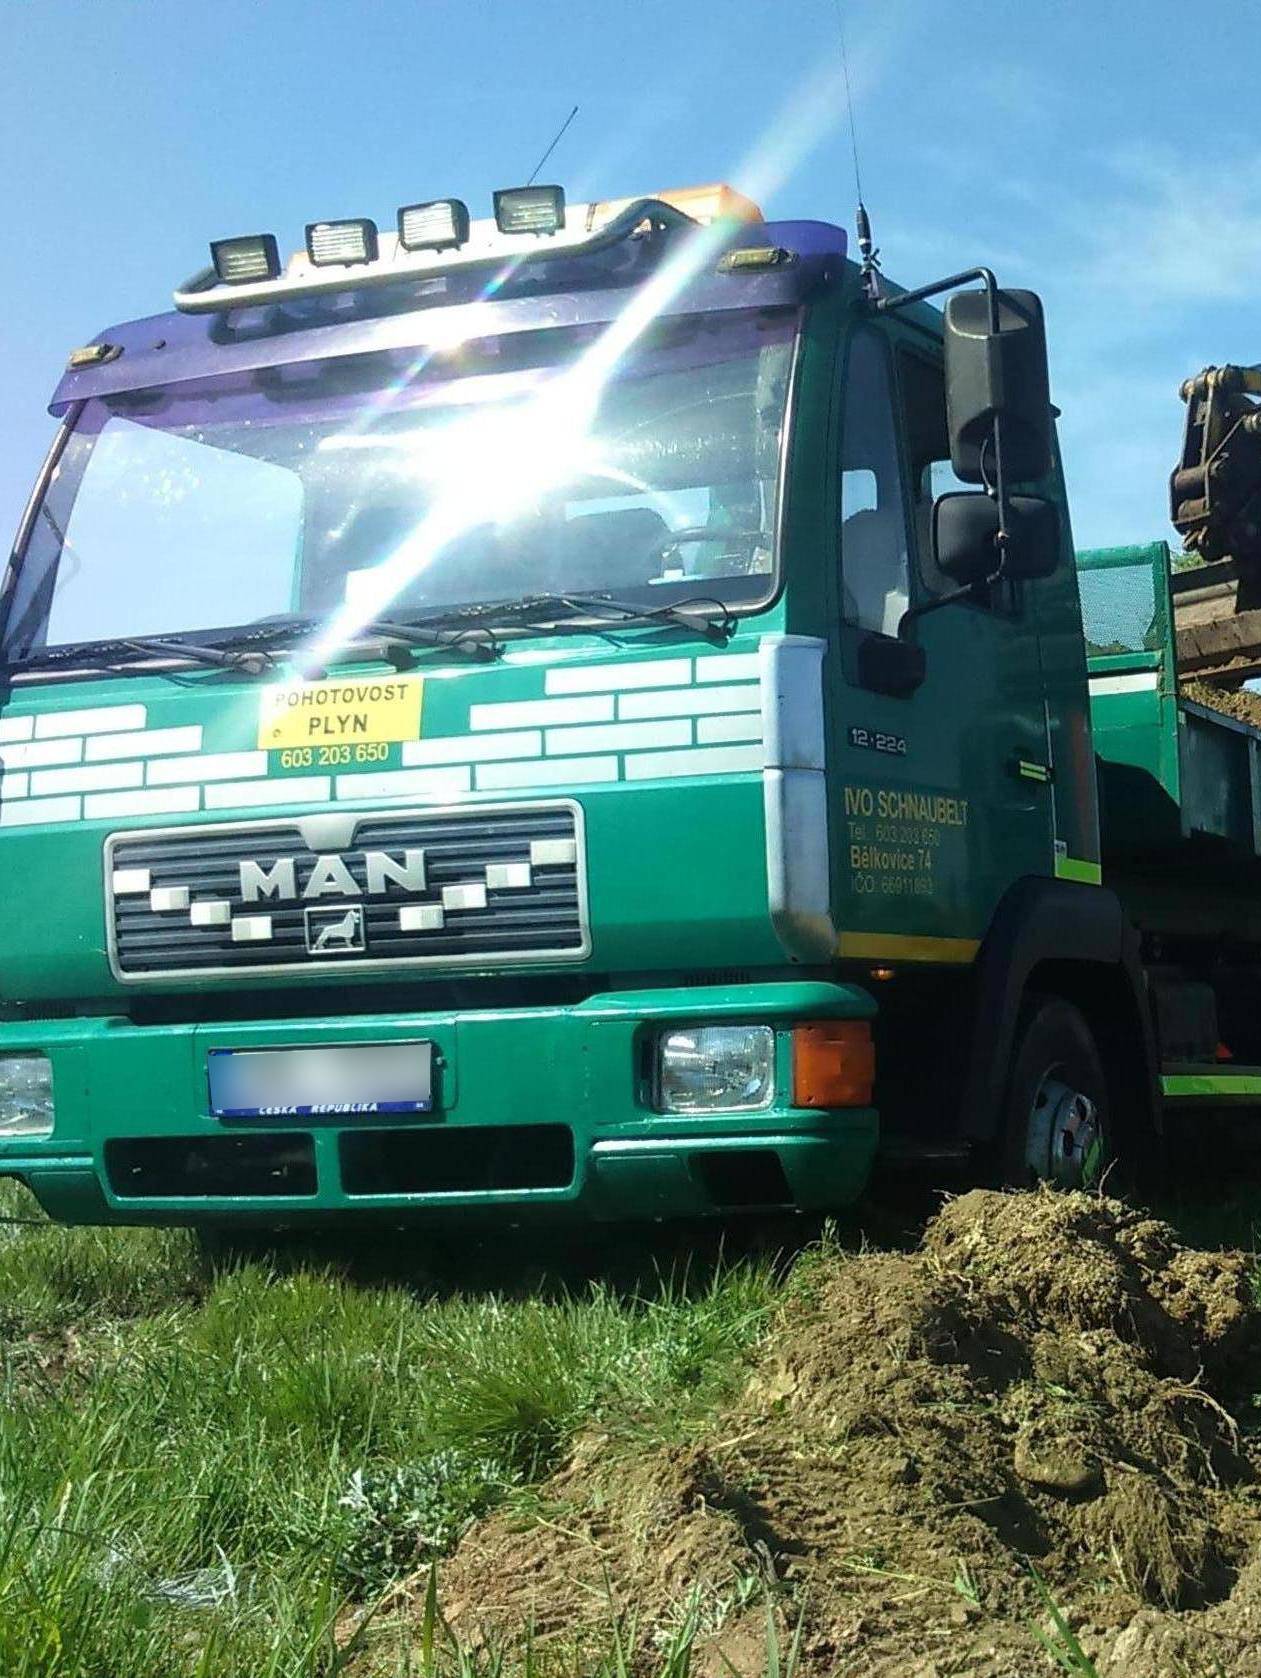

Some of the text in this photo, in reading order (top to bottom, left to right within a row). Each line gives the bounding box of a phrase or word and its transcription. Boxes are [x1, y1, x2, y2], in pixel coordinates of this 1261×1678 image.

[275, 684, 409, 707] POHOTOVOST
[308, 714, 369, 736] PLYN
[281, 743, 389, 768] 603 203 650
[844, 787, 969, 826] IVO SCHNAUBELT
[918, 848, 932, 870] 74
[239, 850, 428, 902] MAN
[310, 1103, 379, 1114] REPUBLIKA
